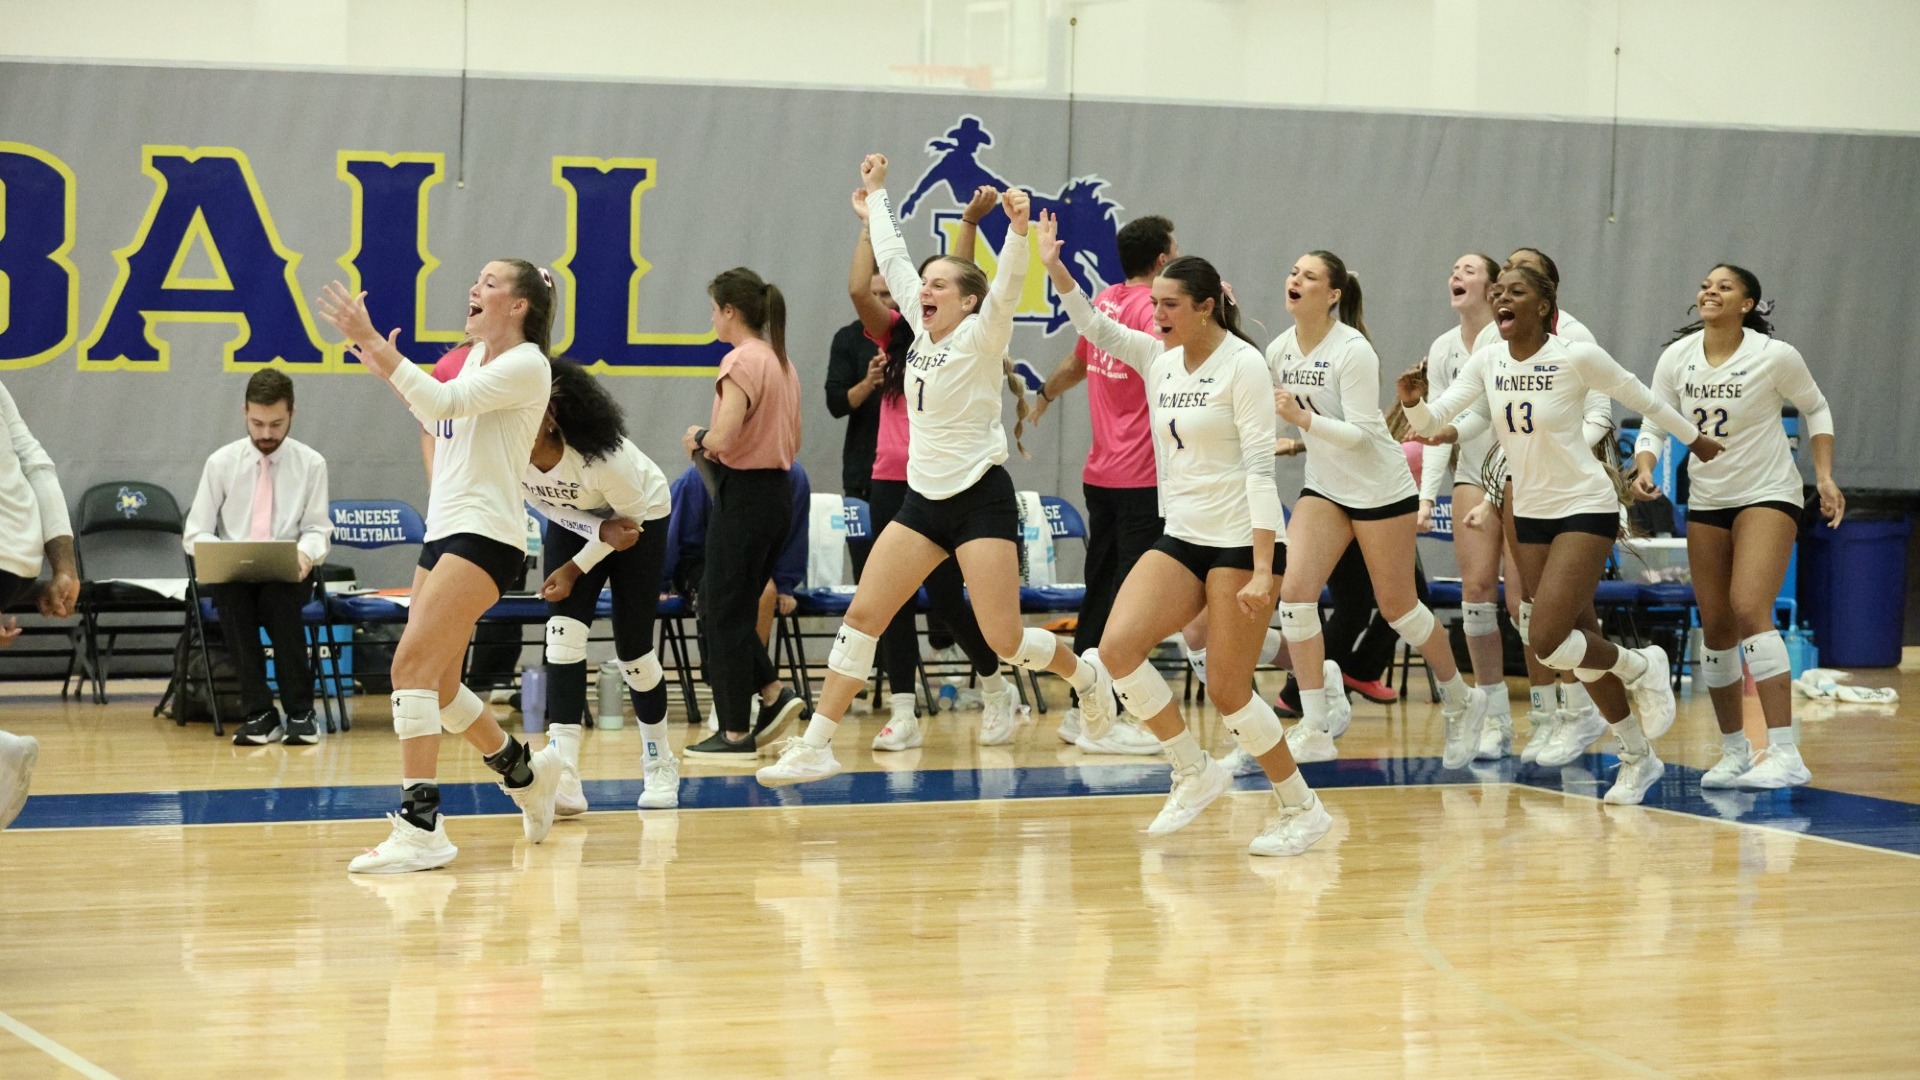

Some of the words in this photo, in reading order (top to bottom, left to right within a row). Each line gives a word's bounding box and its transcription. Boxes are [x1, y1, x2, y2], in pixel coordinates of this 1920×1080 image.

[1281, 369, 1326, 387] McNEESE
[1495, 374, 1554, 392] McNEESE
[915, 377, 925, 412] 7
[1158, 392, 1210, 408] McNEESE
[1684, 383, 1743, 399] McNEESE
[1505, 401, 1535, 434] 13
[1693, 407, 1729, 437] 22
[1168, 418, 1185, 450] 1
[334, 508, 402, 526] McNEESE
[333, 526, 407, 543] VOLLEYBALL
